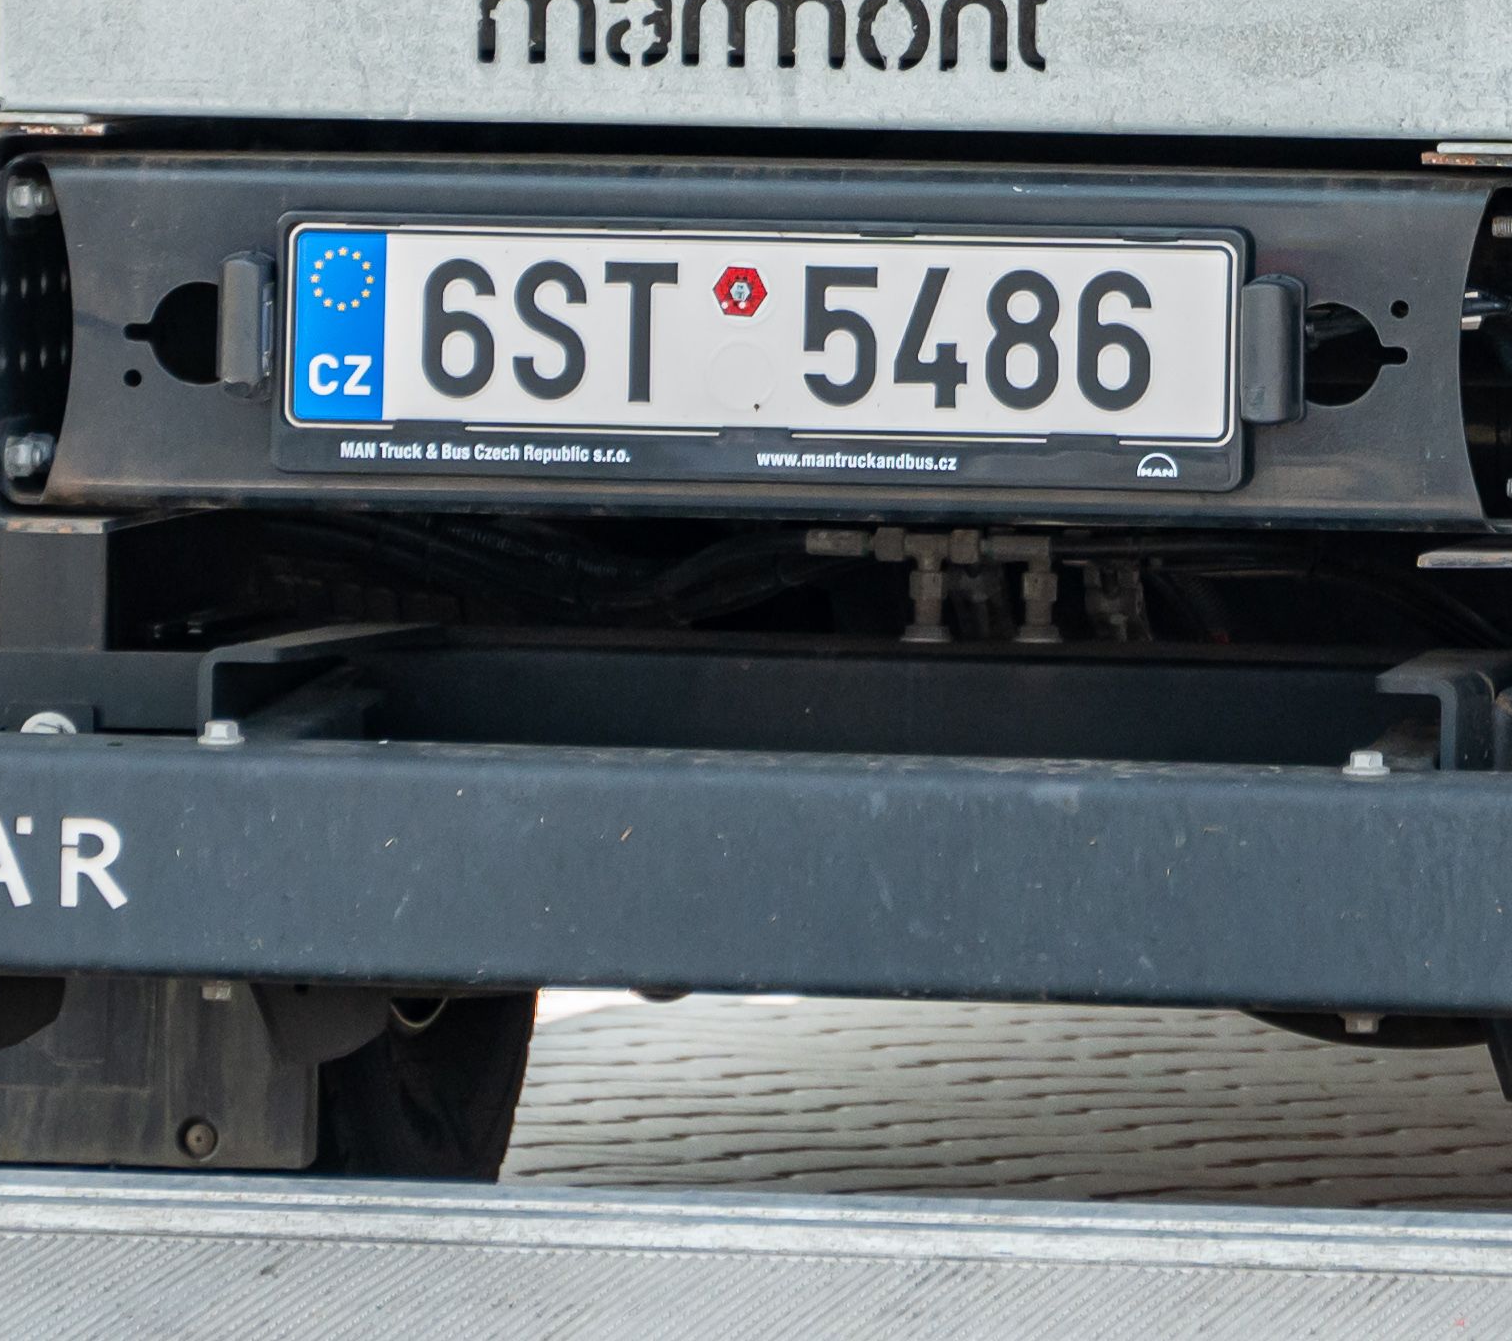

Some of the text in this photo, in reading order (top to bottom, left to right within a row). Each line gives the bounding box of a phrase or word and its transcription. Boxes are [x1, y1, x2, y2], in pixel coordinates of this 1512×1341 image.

[419, 256, 1152, 413] 6ST 5486
[307, 354, 373, 397] CZ
[340, 441, 632, 465] MAN Truck & Bus Czech Republic s.r.o.
[756, 451, 957, 472] www.mantruckandbus.cz
